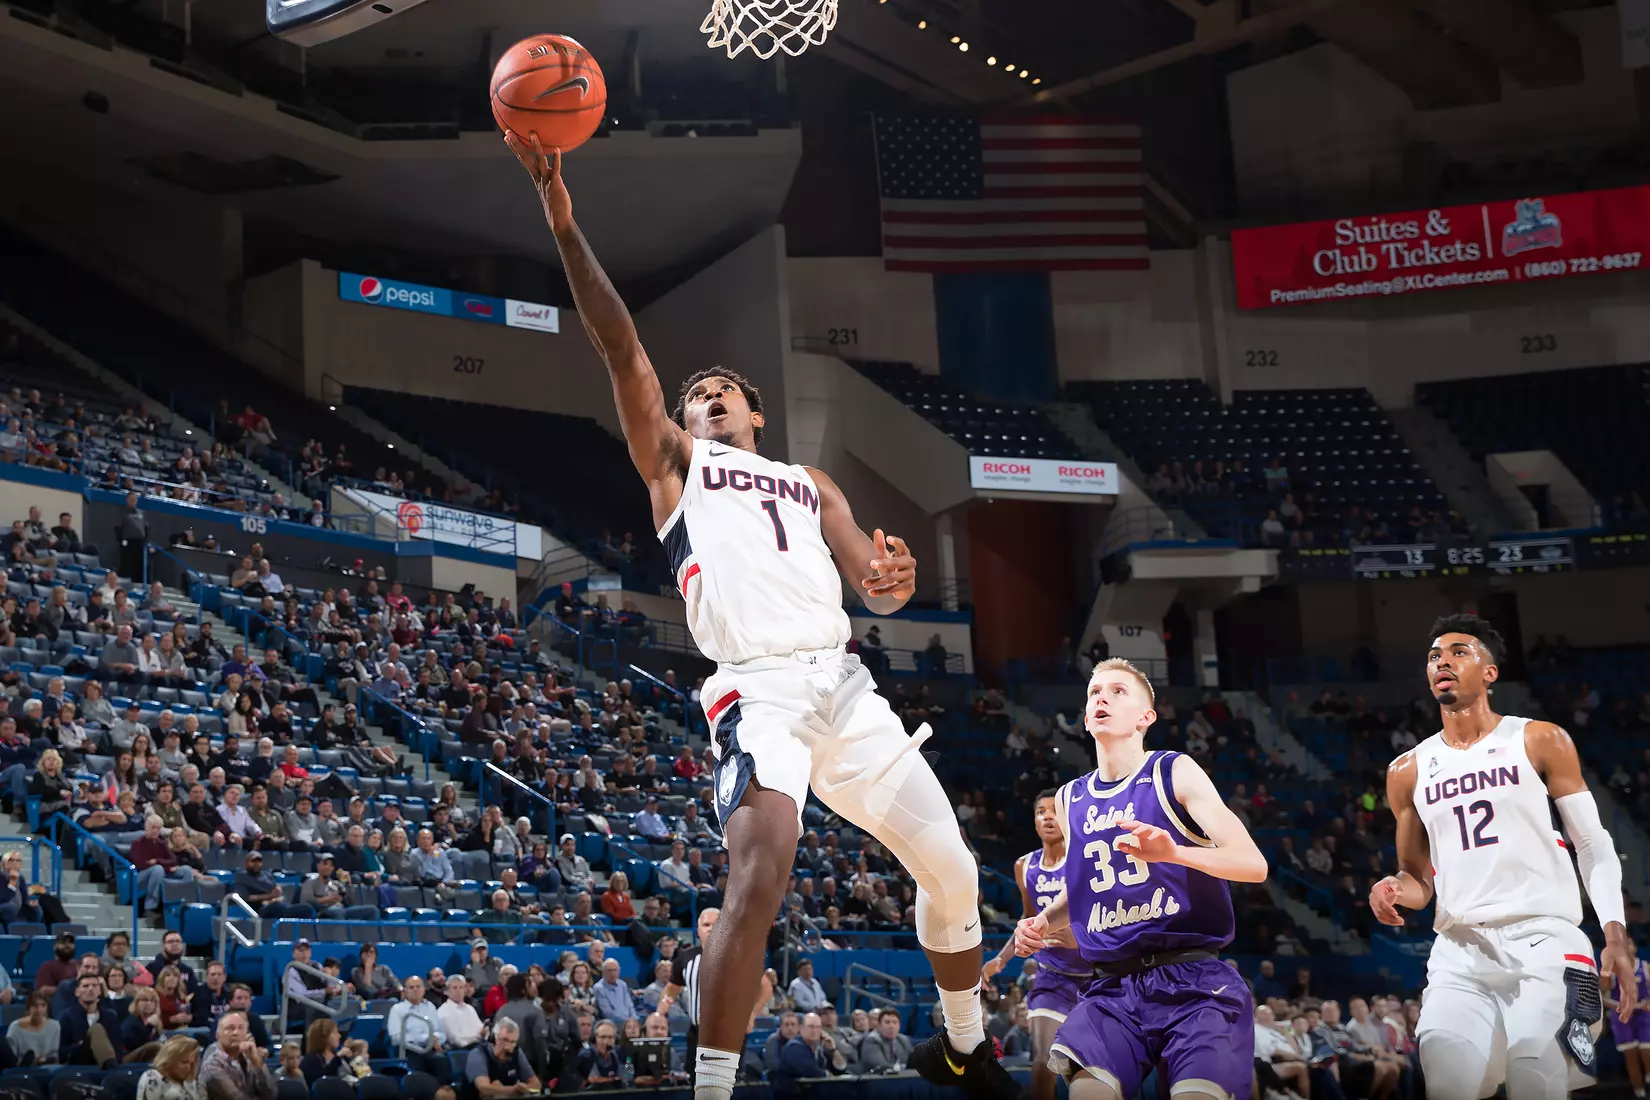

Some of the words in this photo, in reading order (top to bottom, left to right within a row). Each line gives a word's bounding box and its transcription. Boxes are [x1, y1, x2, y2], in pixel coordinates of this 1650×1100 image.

[1334, 216, 1421, 246] Suites
[1424, 209, 1451, 237] &
[1312, 246, 1378, 276] Club
[1381, 239, 1481, 270] Tickets
[386, 286, 434, 307] pepsi
[828, 327, 858, 345] 231
[1520, 334, 1557, 354] 233
[452, 355, 484, 374] 207
[1245, 349, 1278, 367] 232
[983, 462, 1031, 475] RICOH
[1058, 465, 1105, 479] RICOH
[702, 466, 819, 516] UCONN
[240, 517, 267, 535] 105
[761, 499, 789, 552] 1
[1447, 547, 1485, 564] 8:25
[1498, 545, 1523, 562] 23
[1118, 625, 1143, 637] 107
[1425, 765, 1520, 805] UCONN
[1083, 801, 1136, 835] Saint
[1452, 799, 1499, 852] 12
[1083, 833, 1150, 894] 33
[1087, 887, 1180, 934] Michael's
